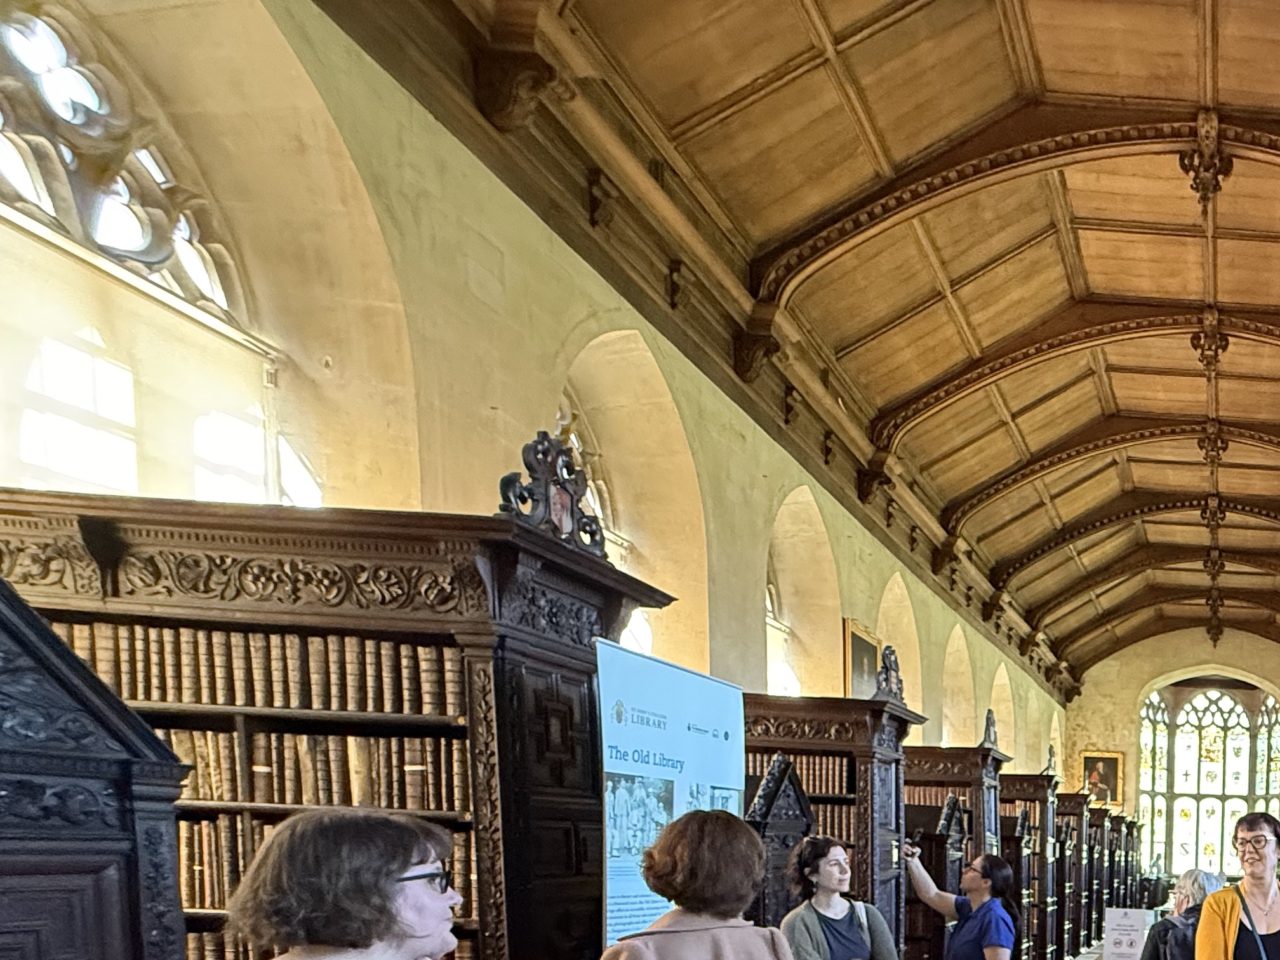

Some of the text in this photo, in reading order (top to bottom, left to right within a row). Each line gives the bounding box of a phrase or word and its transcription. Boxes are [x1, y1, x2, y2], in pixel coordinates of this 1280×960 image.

[631, 713, 667, 731] LIBRARY
[608, 745, 685, 773] The Old Library
